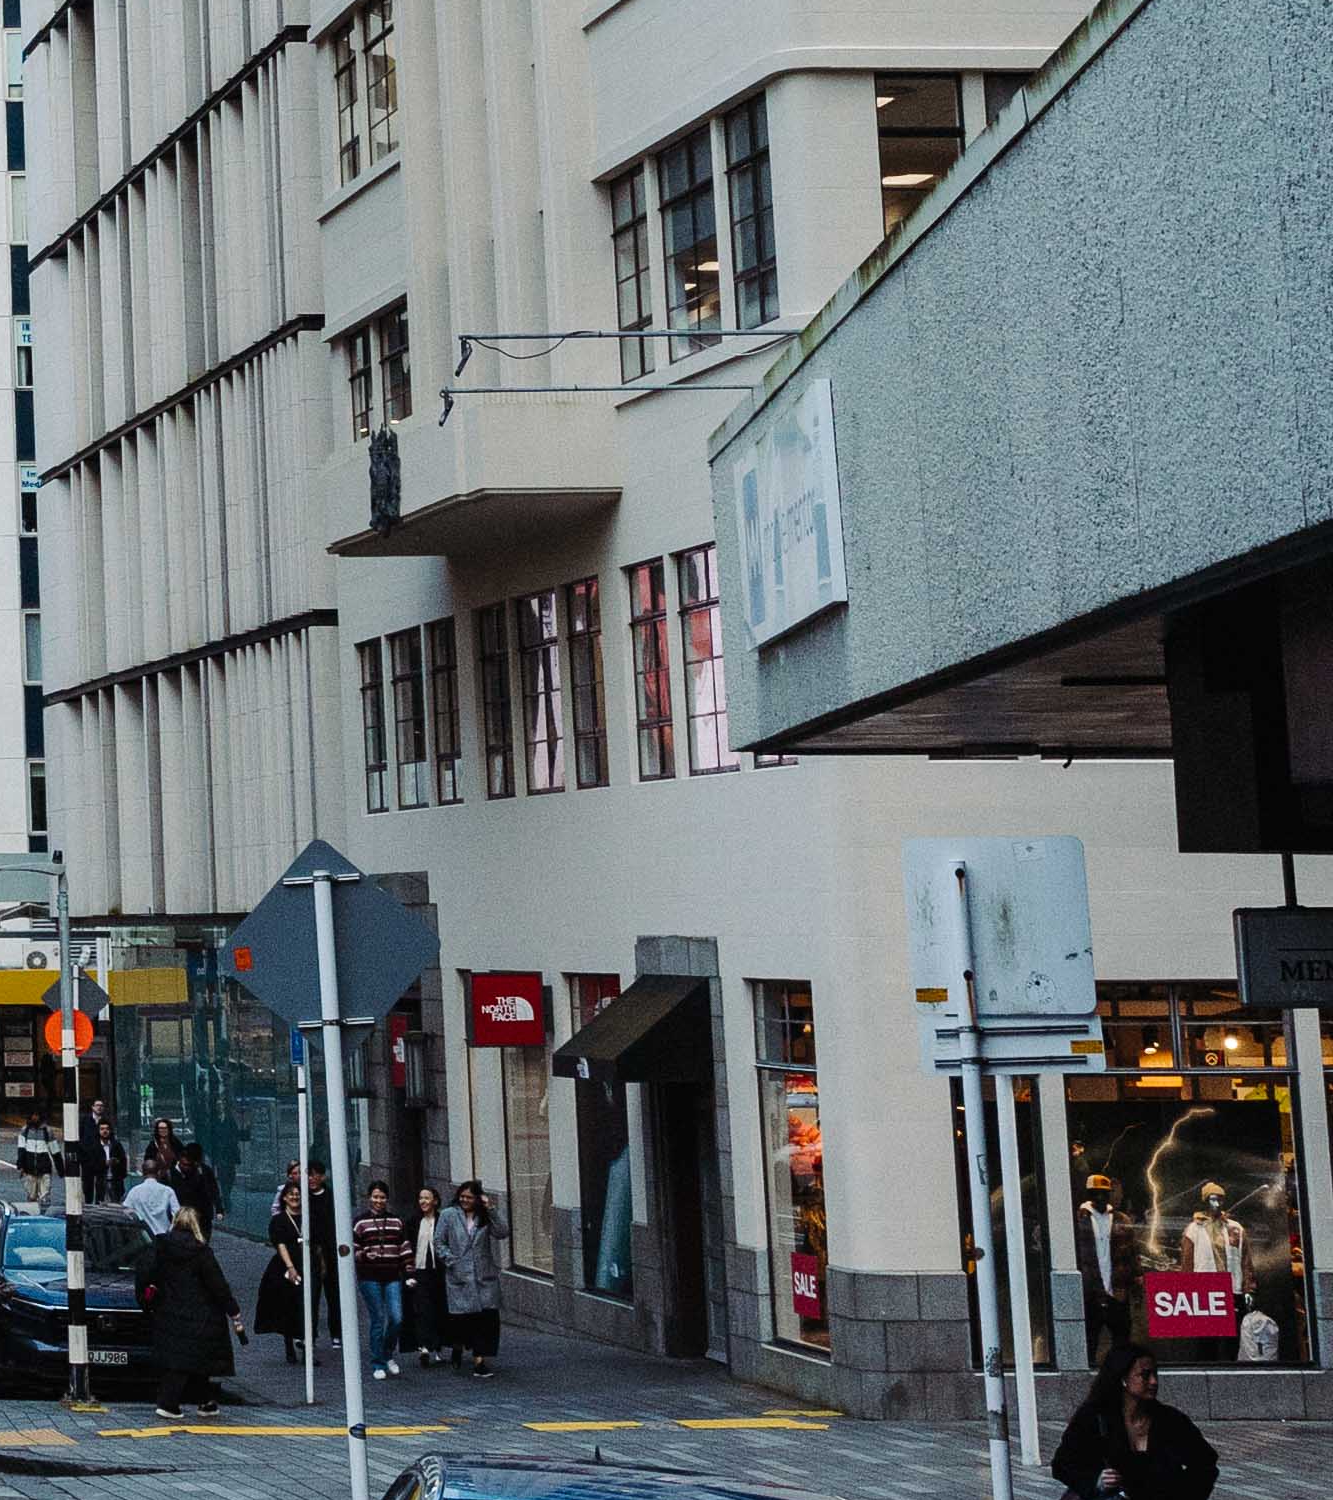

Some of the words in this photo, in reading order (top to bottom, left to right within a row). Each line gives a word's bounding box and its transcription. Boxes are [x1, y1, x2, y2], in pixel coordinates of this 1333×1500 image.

[495, 996, 516, 1005] THE
[481, 1004, 516, 1014] NORTH
[492, 1012, 516, 1021] FACE
[794, 1271, 817, 1300] SALE
[1154, 1291, 1228, 1318] SALE
